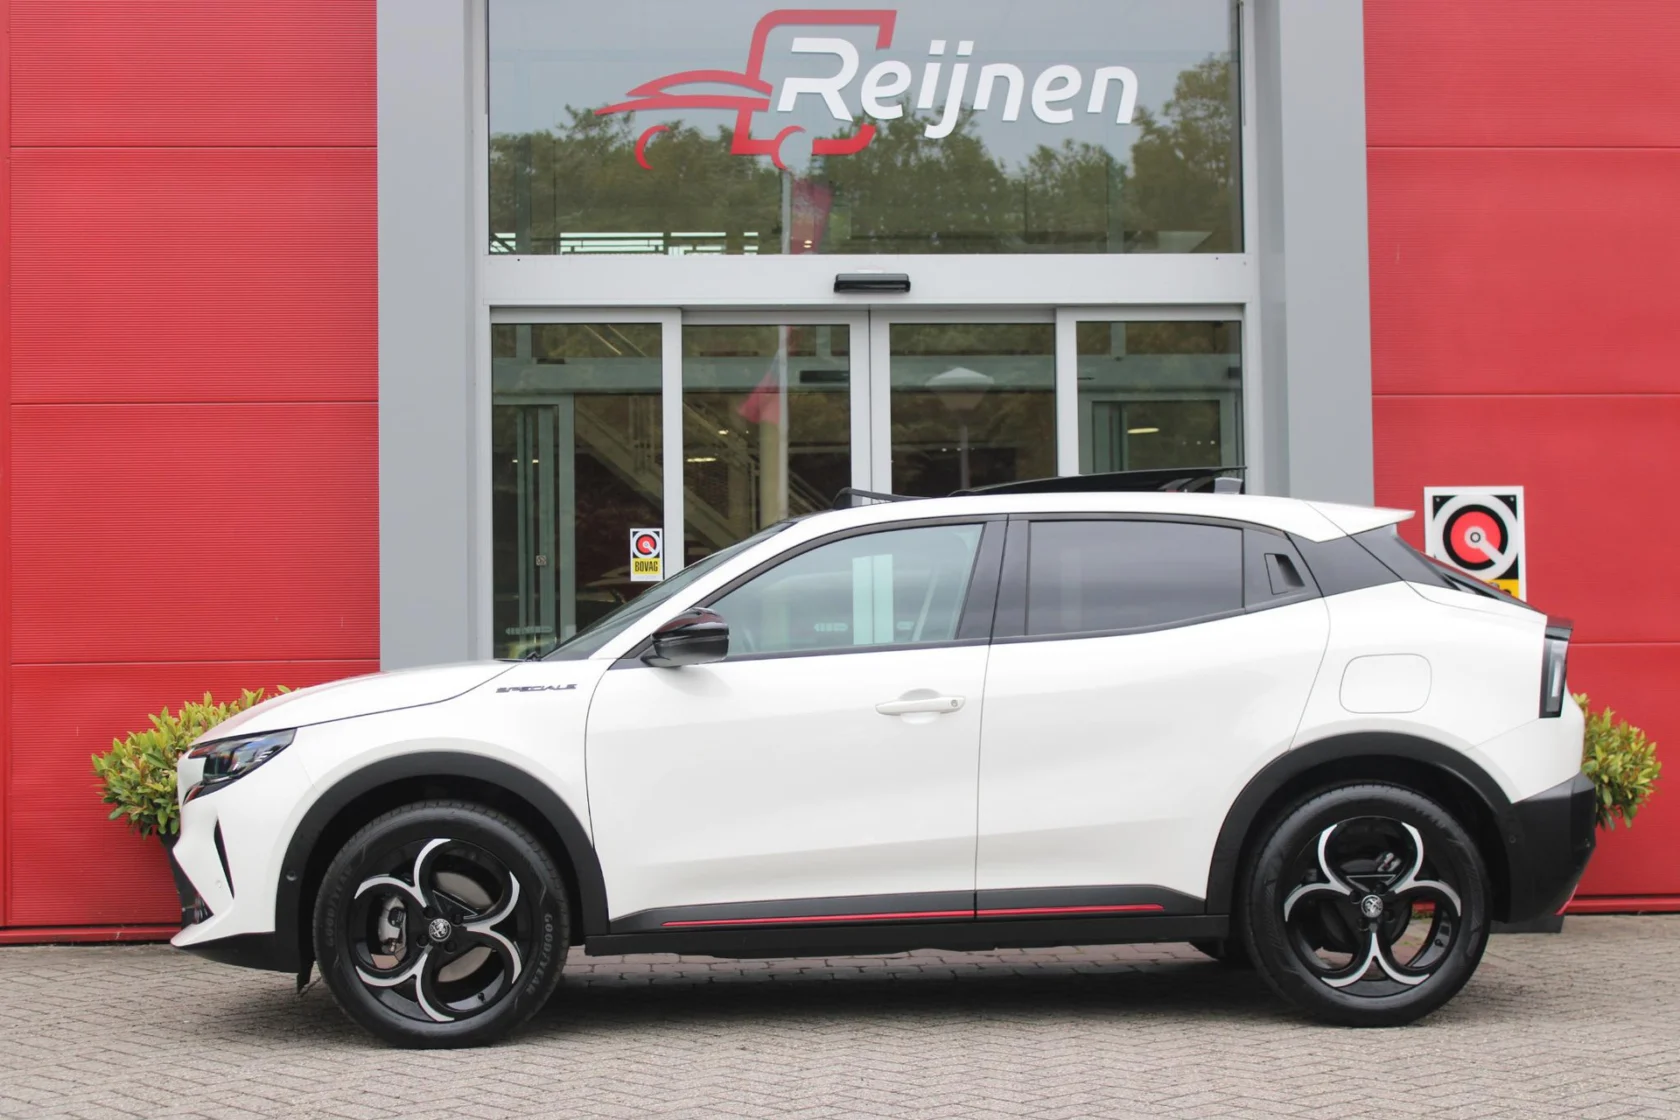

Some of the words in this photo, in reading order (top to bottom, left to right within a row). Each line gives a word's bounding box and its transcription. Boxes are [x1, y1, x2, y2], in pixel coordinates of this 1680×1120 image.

[777, 37, 1139, 139] Reijnen
[634, 560, 659, 572] BOVAG
[496, 683, 577, 694] SPECIALE
[526, 912, 554, 996] GOODYEAR
